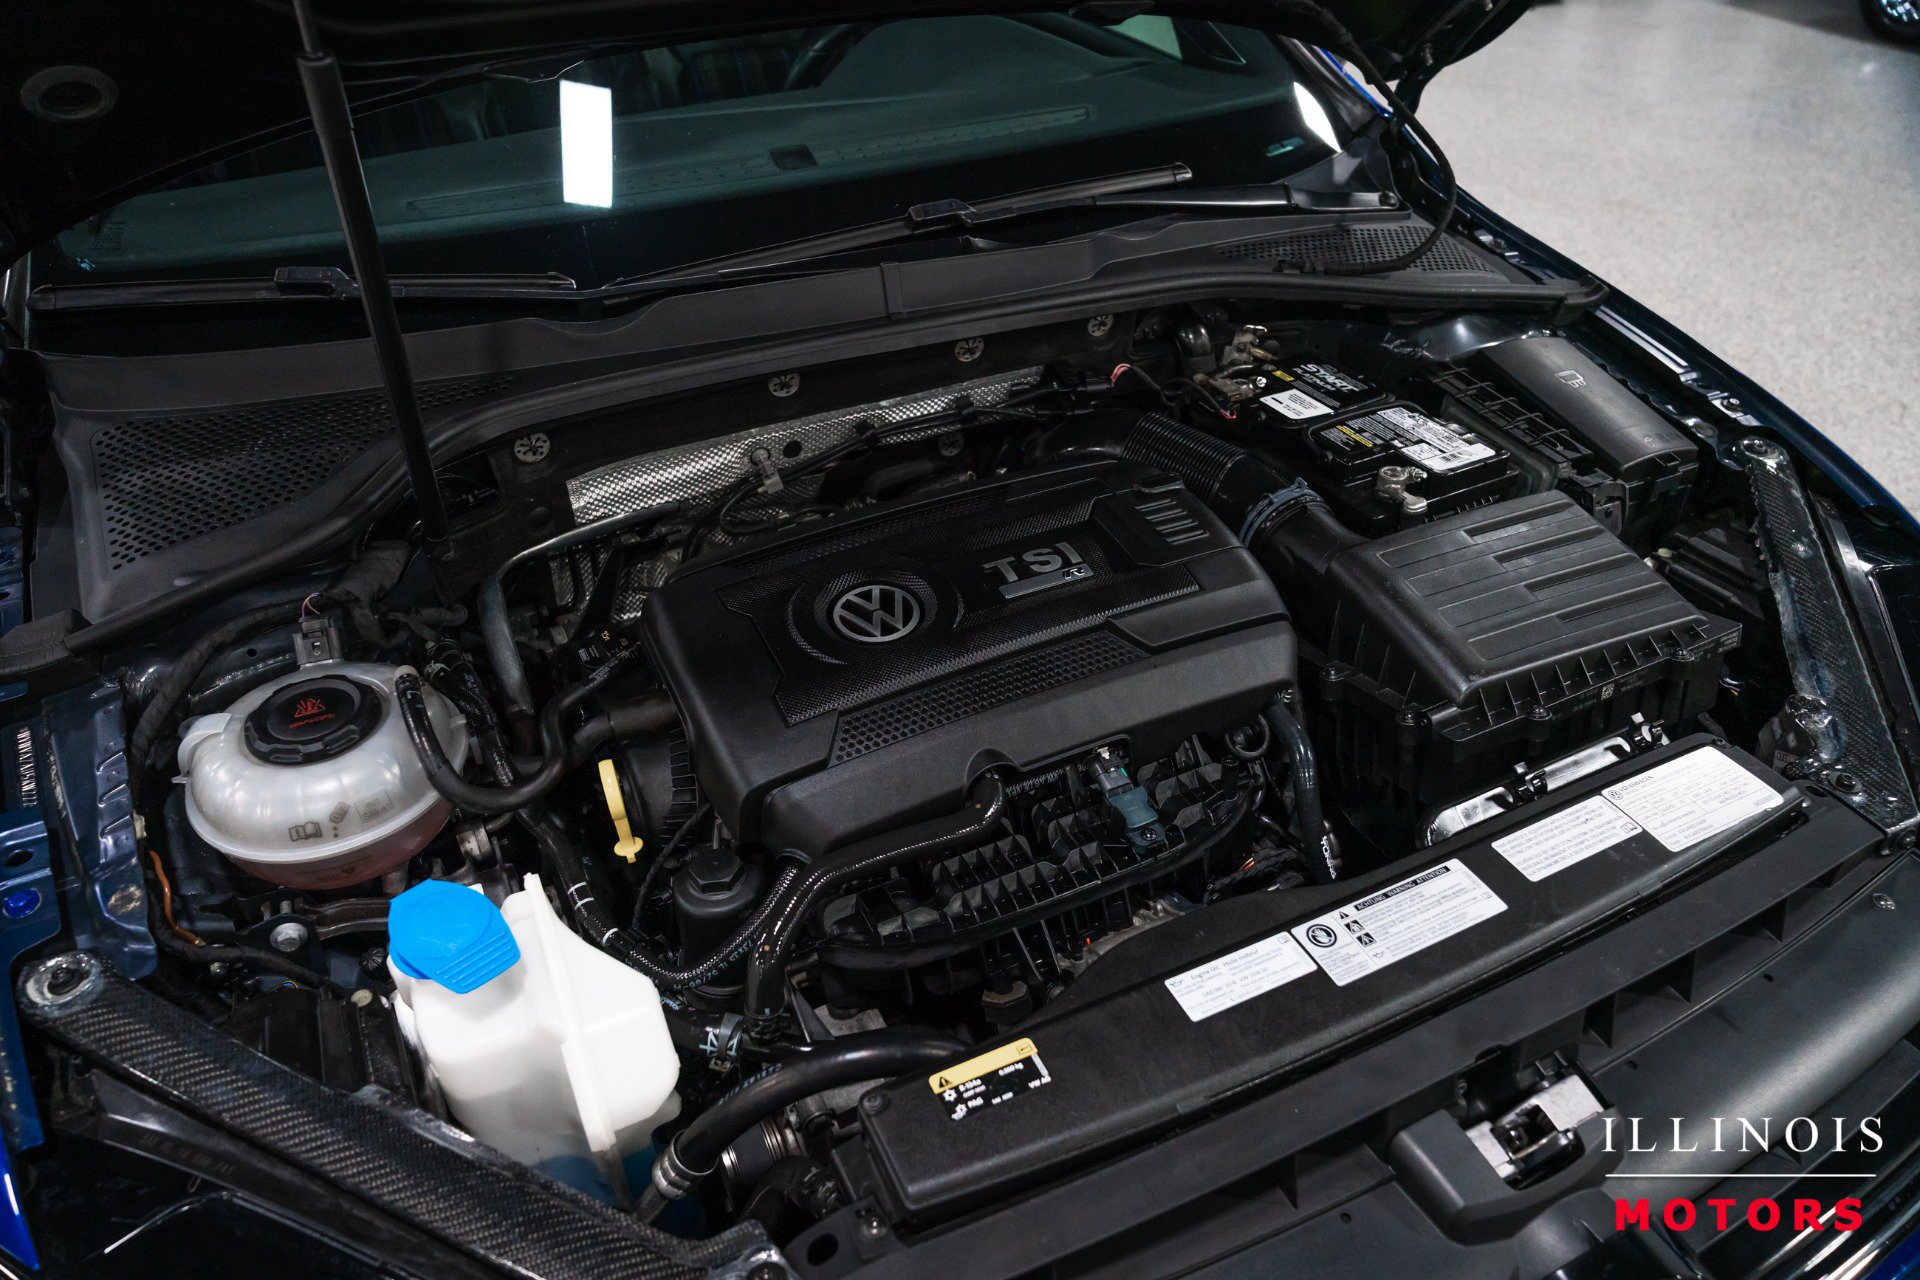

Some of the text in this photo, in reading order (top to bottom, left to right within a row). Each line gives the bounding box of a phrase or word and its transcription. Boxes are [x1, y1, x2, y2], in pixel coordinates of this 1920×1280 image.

[983, 542, 1084, 583] TSI
[1617, 774, 1654, 792] VOLKSWAGEN
[1355, 893, 1386, 910] ACHTUNG
[1385, 881, 1415, 896] WARNING
[1414, 867, 1447, 883] ATTENTION
